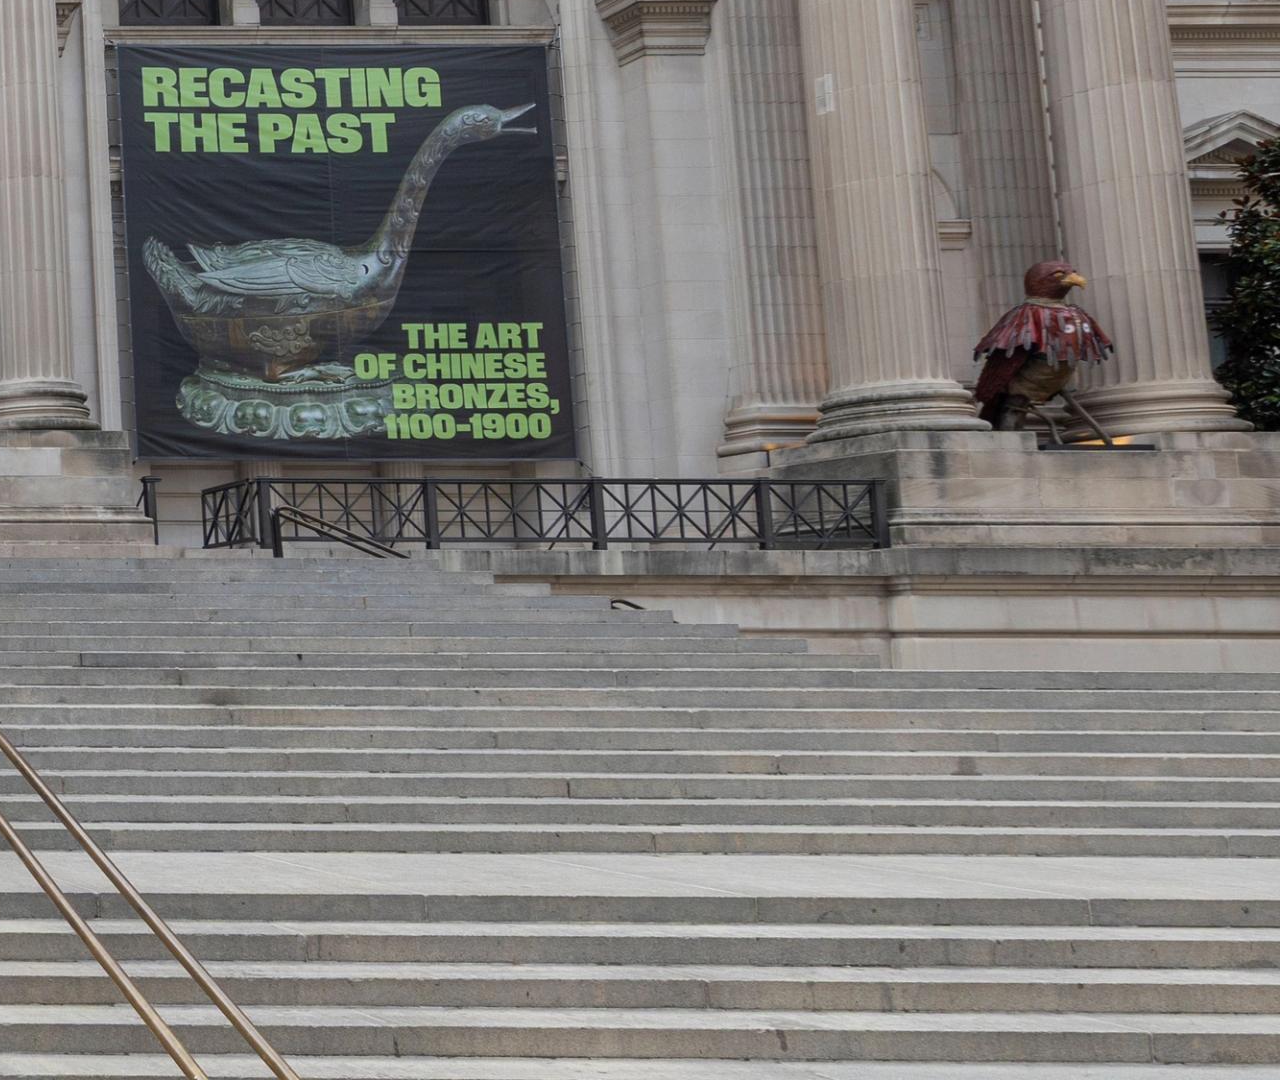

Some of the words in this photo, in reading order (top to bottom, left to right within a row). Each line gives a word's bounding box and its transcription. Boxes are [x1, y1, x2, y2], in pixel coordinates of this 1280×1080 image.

[142, 67, 441, 108] RECASTING
[143, 113, 249, 153] THE
[258, 113, 395, 153] PAST
[402, 323, 468, 349] THE
[475, 322, 543, 348] ART
[354, 353, 397, 379] OF
[403, 353, 546, 379] CHINESE
[393, 383, 560, 414] BRONZES,
